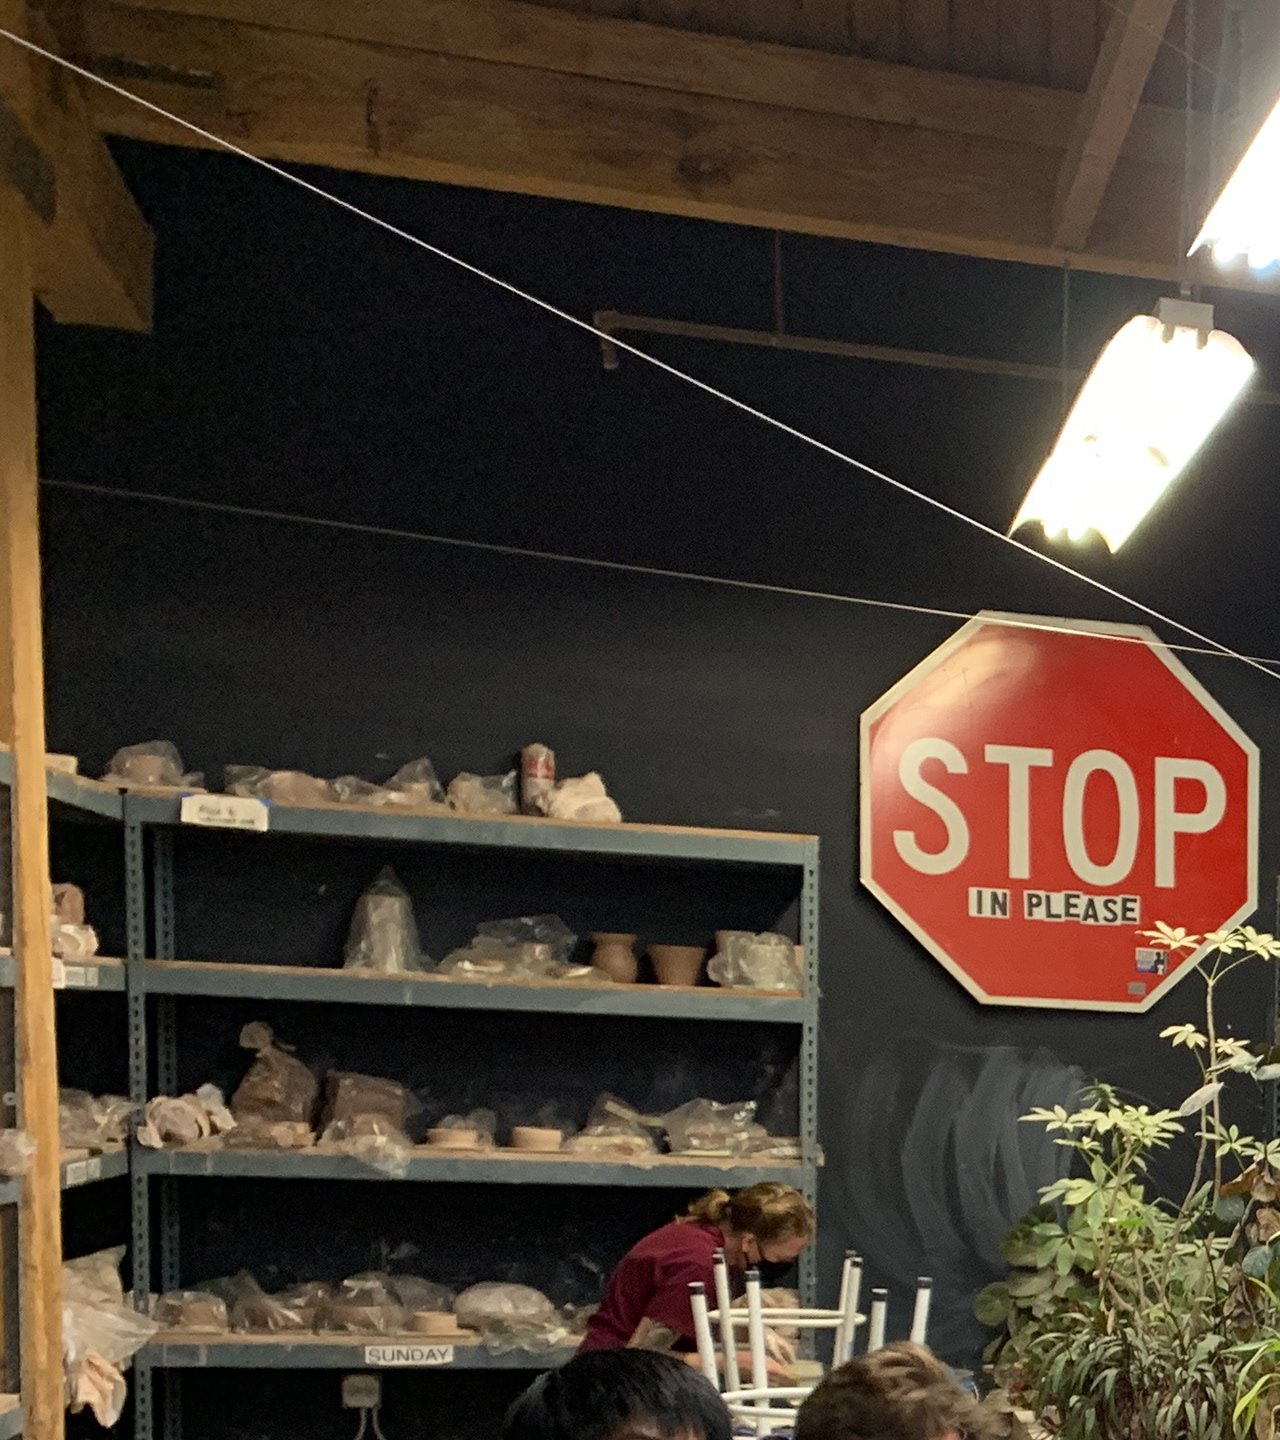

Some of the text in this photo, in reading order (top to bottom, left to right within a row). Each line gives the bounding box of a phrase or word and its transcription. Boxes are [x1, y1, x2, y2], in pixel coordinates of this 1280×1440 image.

[893, 737, 1228, 889] STOP
[976, 889, 1138, 923] IN PLEASE
[368, 1347, 449, 1362] SUNDAY
